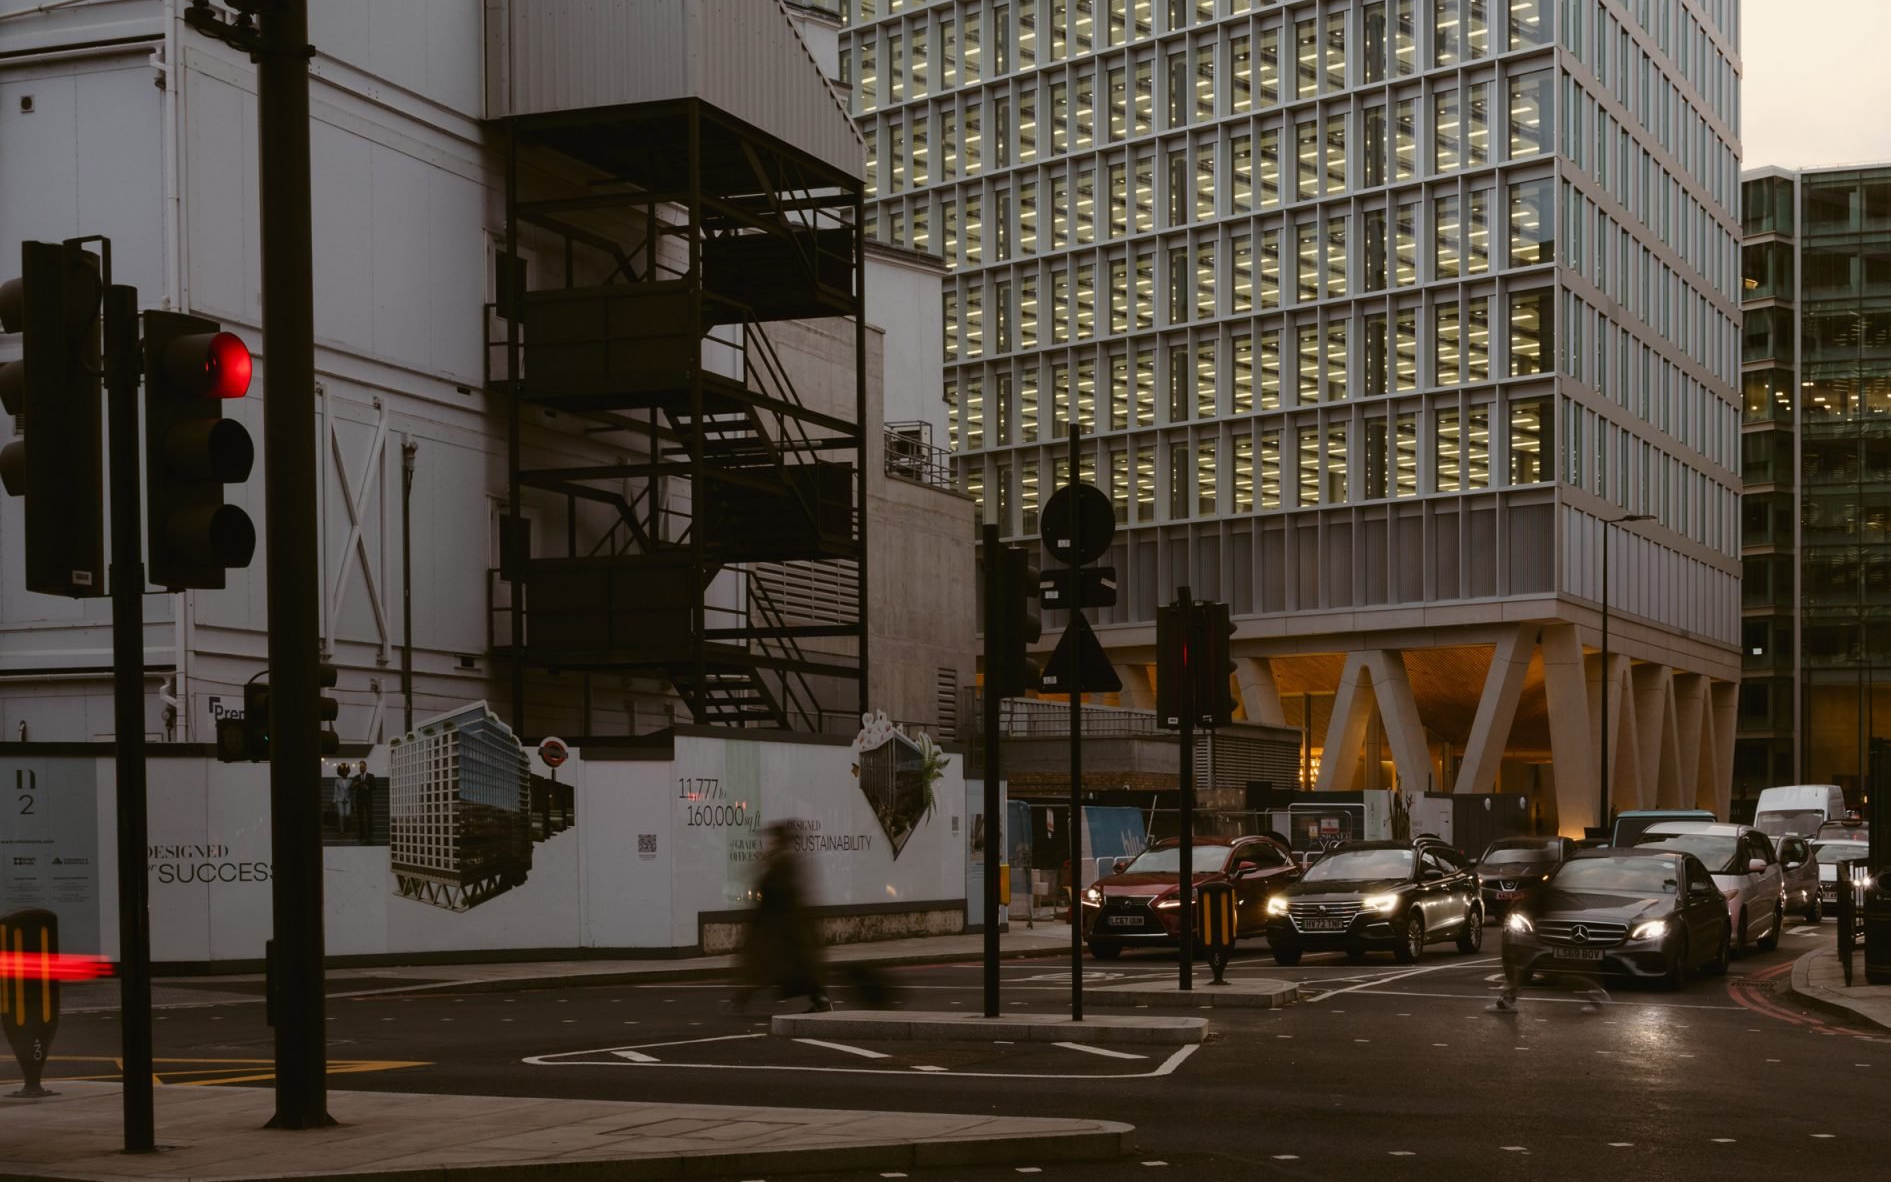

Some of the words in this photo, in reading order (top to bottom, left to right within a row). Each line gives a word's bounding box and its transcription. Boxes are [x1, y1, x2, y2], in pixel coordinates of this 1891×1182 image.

[18, 794, 35, 815] 2
[687, 805, 744, 829] 160,000
[793, 835, 872, 852] SUSTAINABILITY
[158, 862, 273, 884] SUCCES
